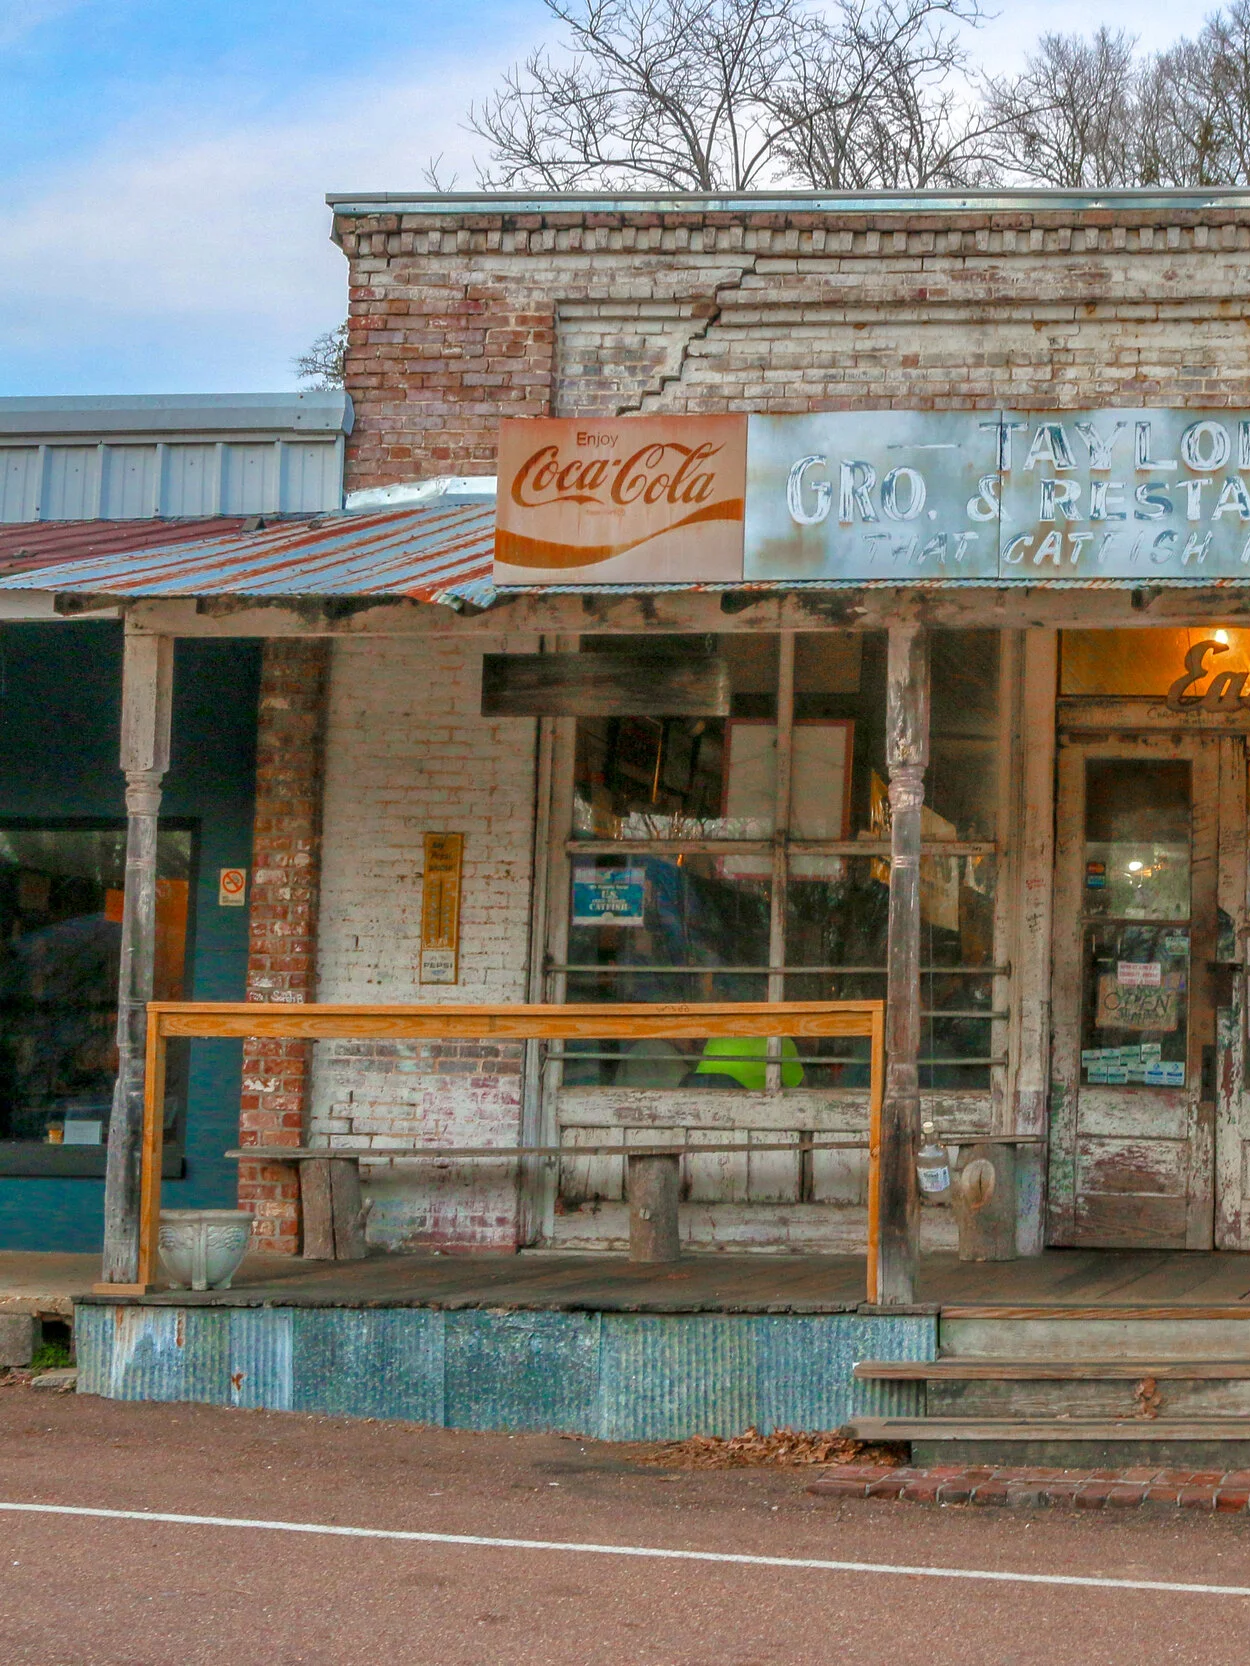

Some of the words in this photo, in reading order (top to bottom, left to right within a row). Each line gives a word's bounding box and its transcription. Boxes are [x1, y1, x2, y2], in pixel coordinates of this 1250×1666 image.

[576, 431, 619, 448] Enjoy
[511, 441, 727, 507] Coca-Cola
[786, 454, 938, 525] GRO.
[966, 474, 1010, 521] &
[862, 531, 979, 565] THAT
[1001, 529, 1214, 566] CATFISH
